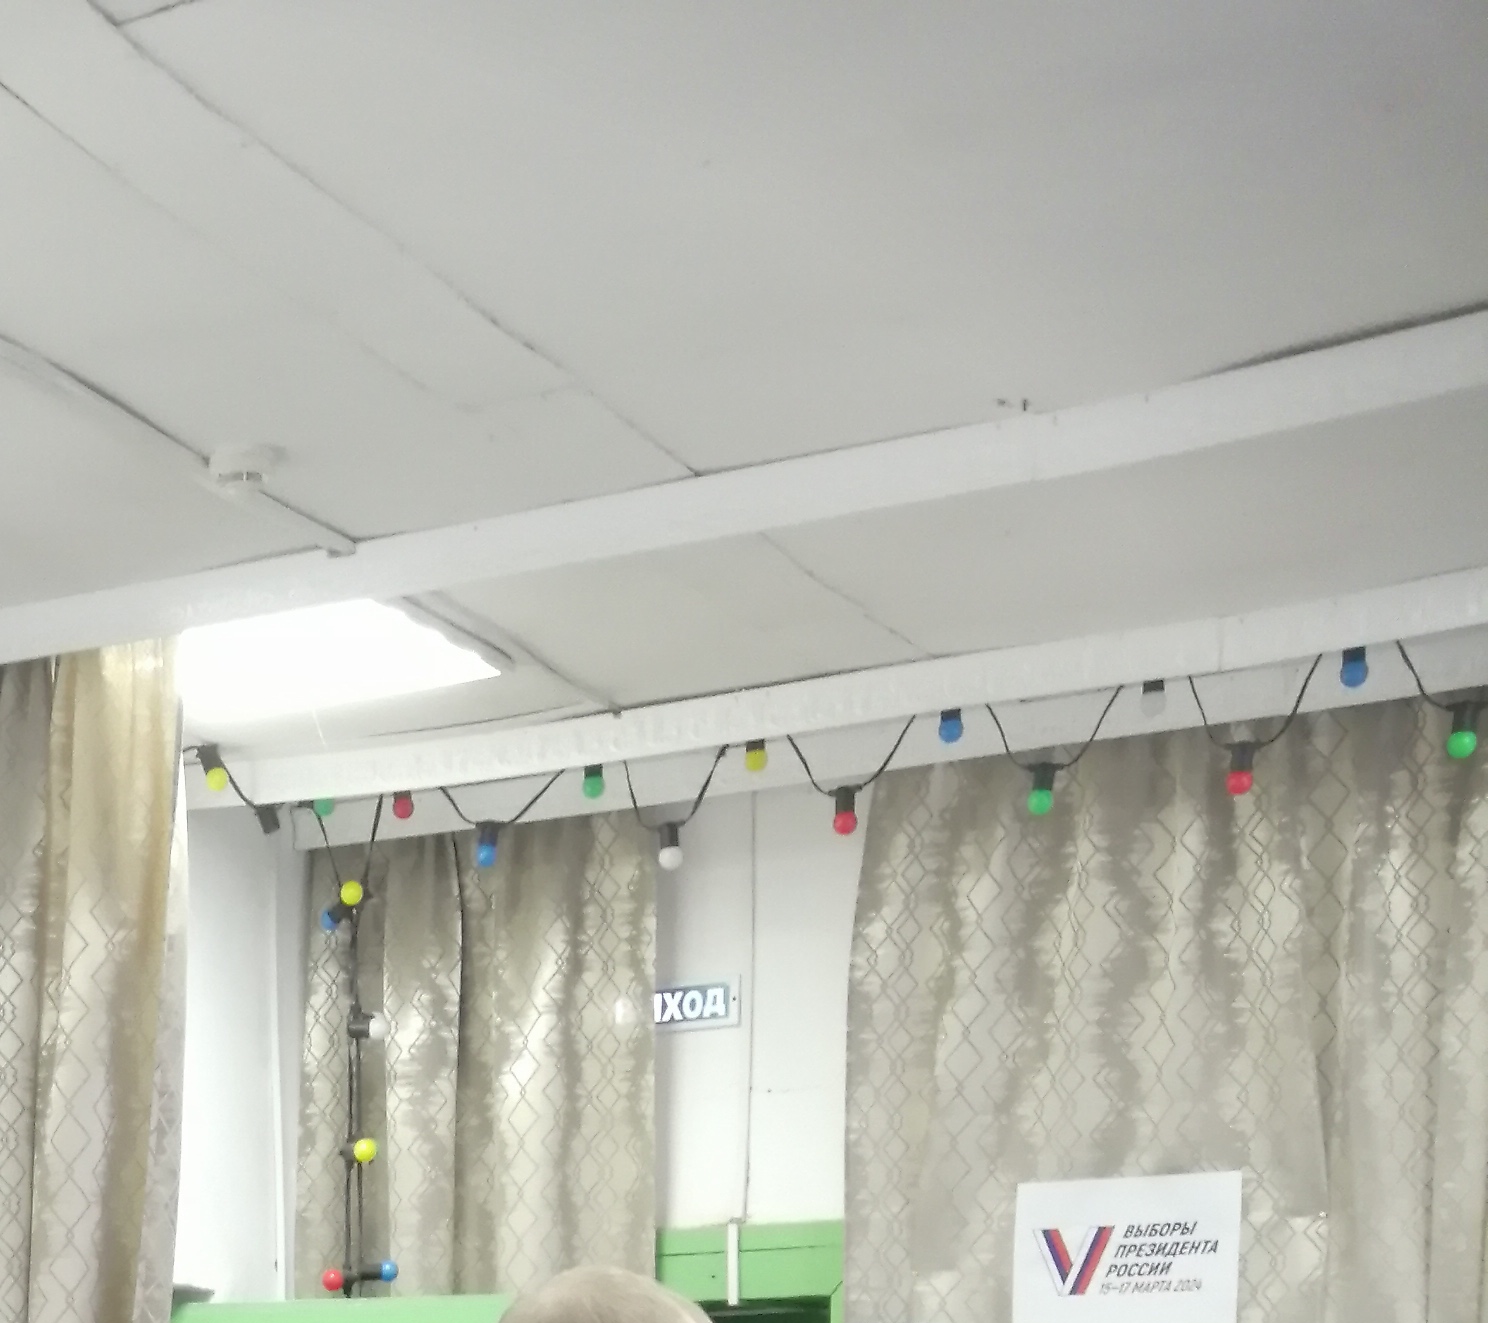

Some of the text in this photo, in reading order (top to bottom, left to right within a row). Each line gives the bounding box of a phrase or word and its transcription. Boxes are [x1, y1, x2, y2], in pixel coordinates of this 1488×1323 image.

[1122, 1220, 1198, 1239] ВЫБОРЫ
[1114, 1239, 1219, 1258] ПРЕЗИДЕНТА
[1105, 1261, 1173, 1278] РОССИИ
[1131, 1280, 1172, 1293] МАРТА
